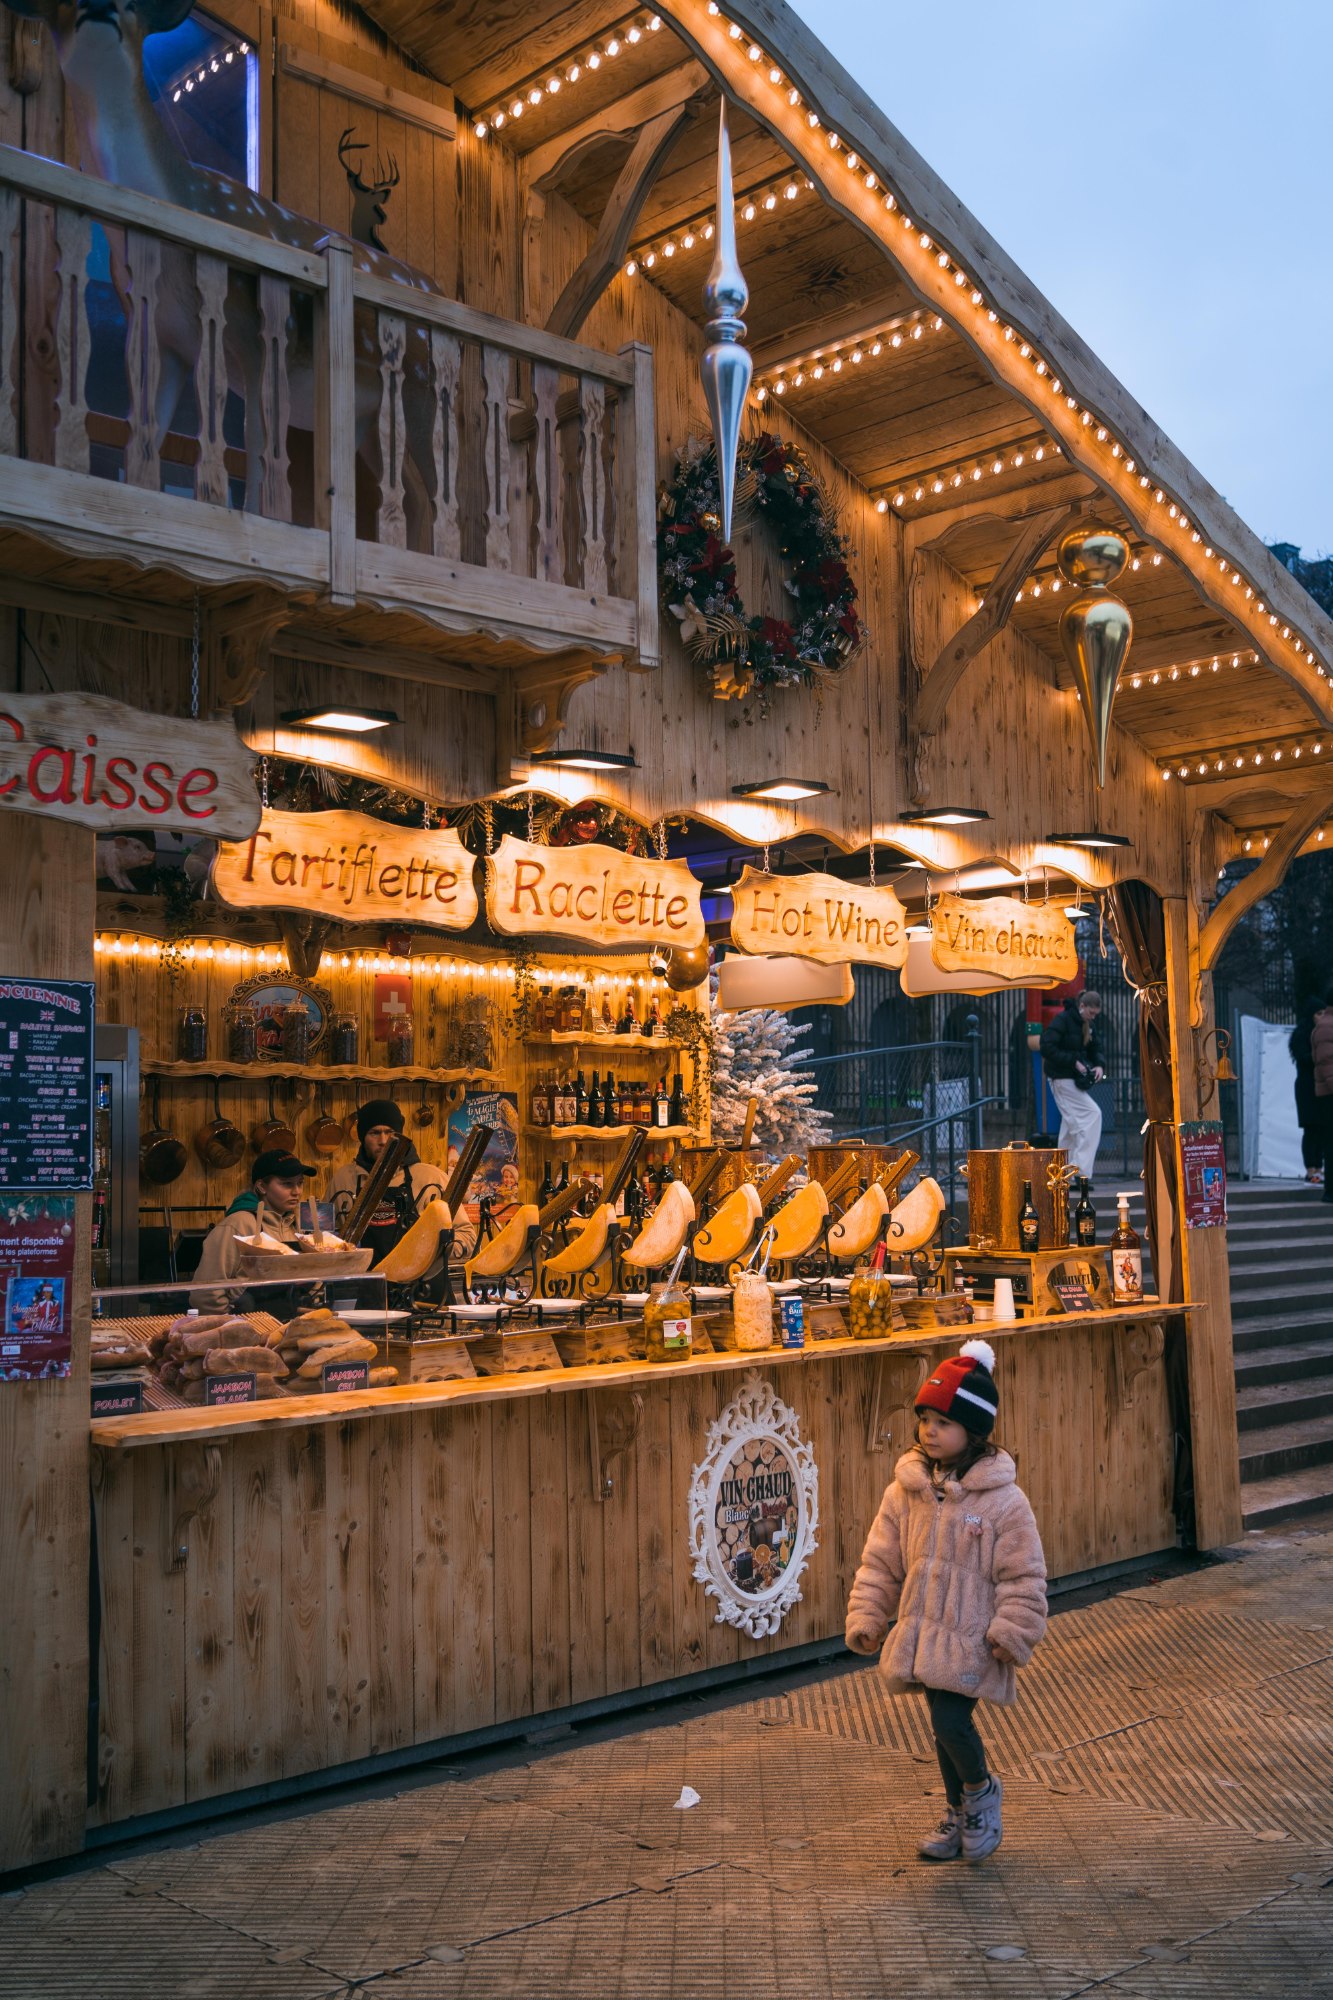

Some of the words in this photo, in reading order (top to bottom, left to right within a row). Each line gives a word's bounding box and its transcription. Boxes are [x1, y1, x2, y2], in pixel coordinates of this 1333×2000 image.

[242, 831, 459, 906] Tartiflette
[510, 859, 689, 931] Raclette
[750, 889, 813, 937] Hot
[825, 898, 899, 948] Wine
[945, 912, 985, 953] Vin
[996, 919, 1070, 961] chaud
[21, 1237, 64, 1246] disponible
[5, 1248, 16, 1256] les
[17, 1248, 58, 1256] plateformes
[327, 1369, 365, 1382] JAMBON
[211, 1381, 252, 1394] JAMBON
[337, 1382, 356, 1391] CRU
[94, 1397, 136, 1411] POULET
[216, 1393, 249, 1404] BLANC
[720, 1479, 743, 1507] VIN
[746, 1470, 793, 1502] CHAUD
[725, 1509, 750, 1523] Blanc
